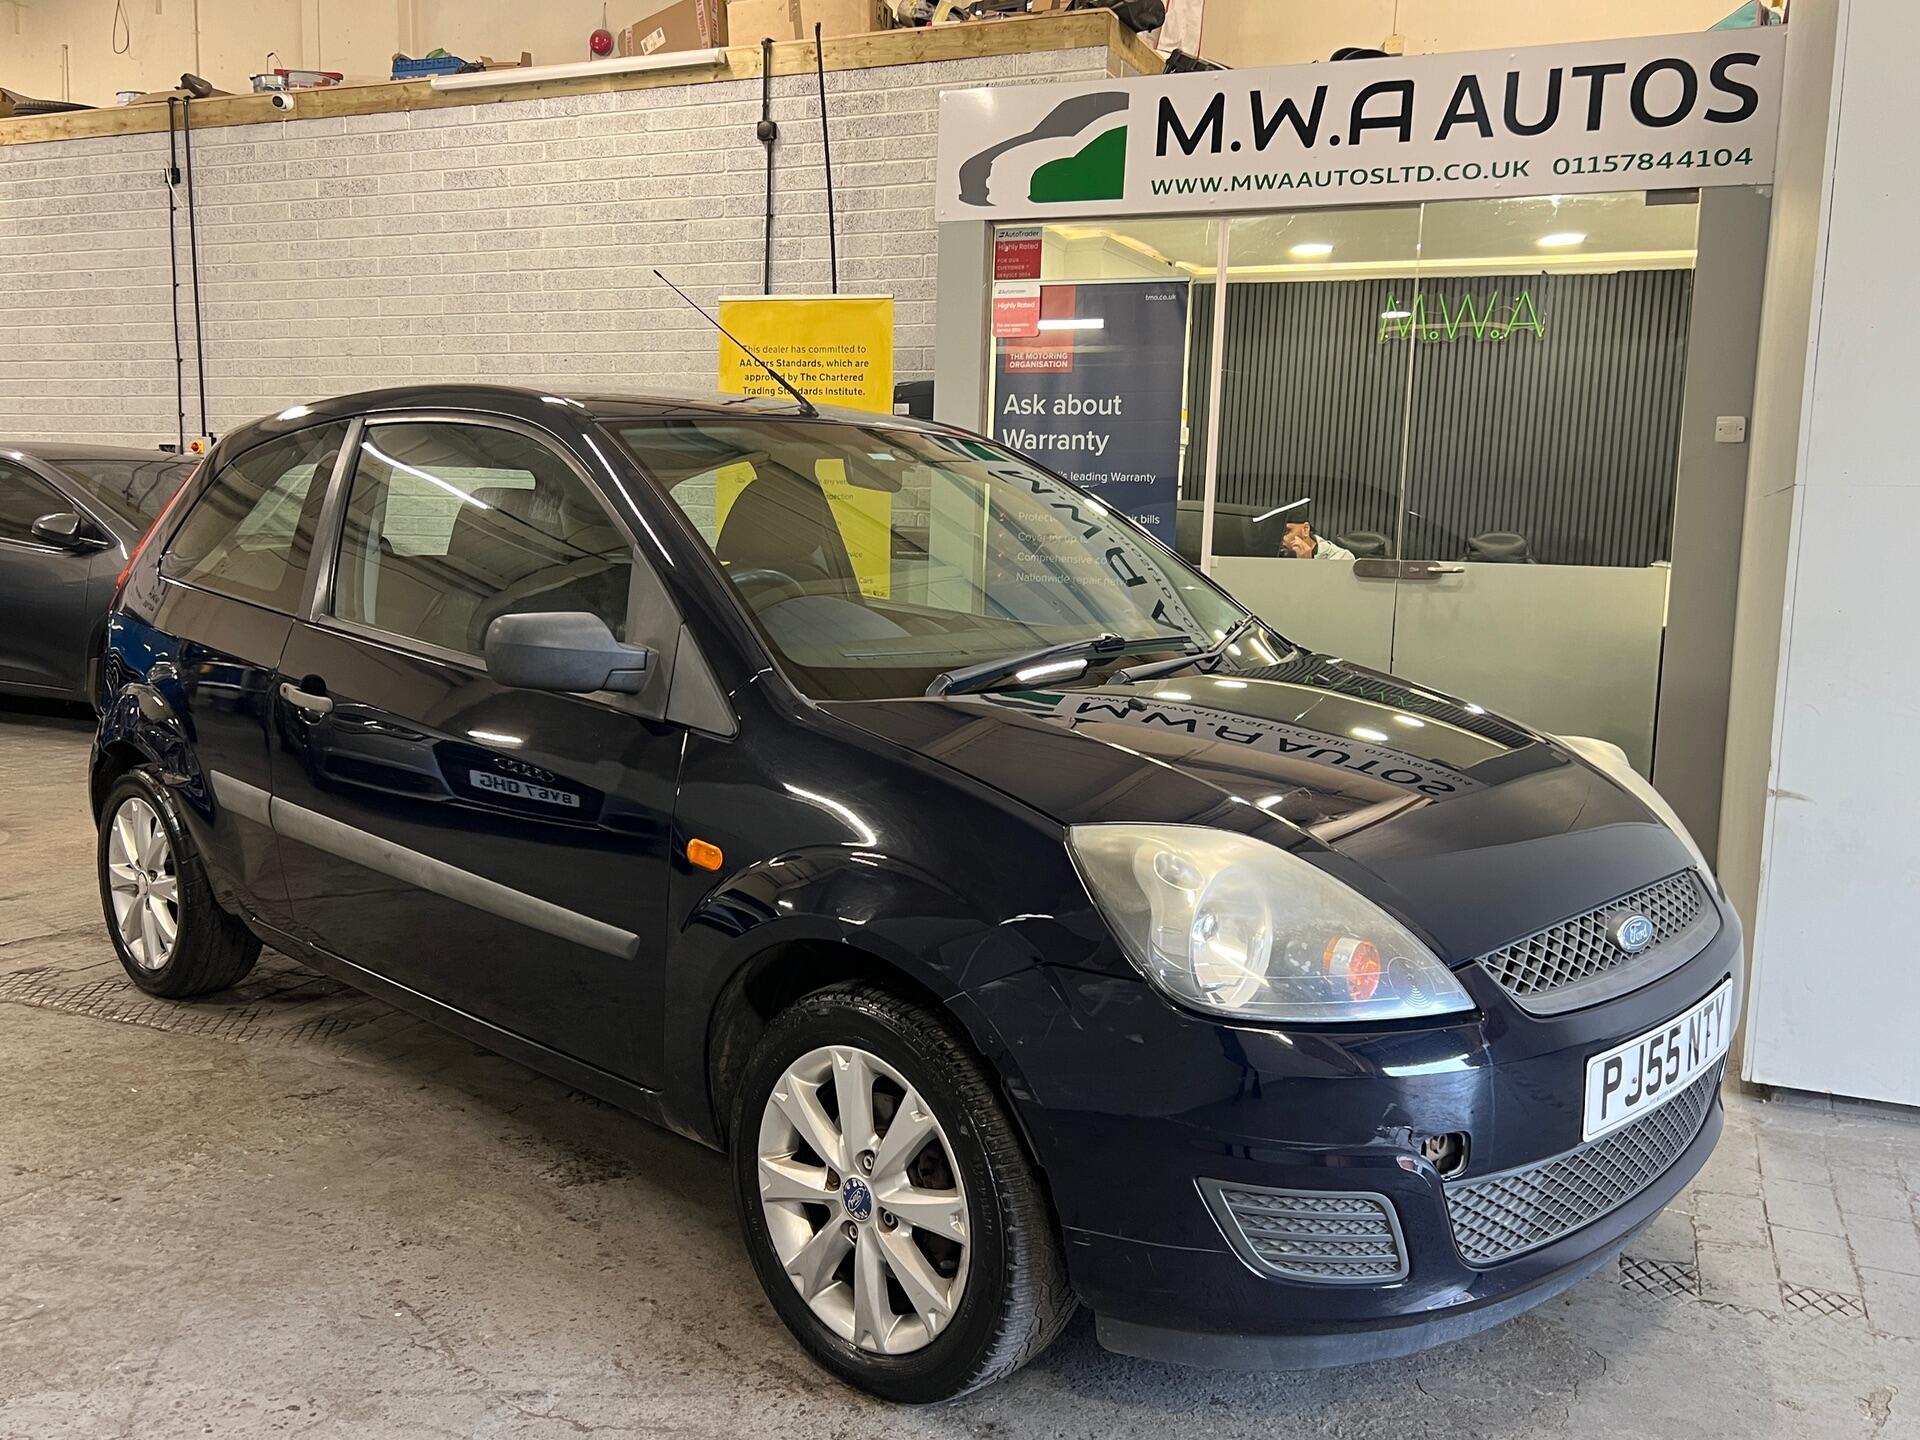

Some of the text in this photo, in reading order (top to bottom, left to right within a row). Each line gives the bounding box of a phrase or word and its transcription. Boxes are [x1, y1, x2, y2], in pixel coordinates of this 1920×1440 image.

[1155, 52, 1761, 157] M.W.A AUTOS
[1151, 147, 1753, 196] WWW.MWAAUTOSLTD.CO.UK 01157844104
[1019, 242, 1039, 250] Rated
[1145, 293, 1177, 301] tmo.co.uk
[1380, 289, 1544, 342] M.W.A
[762, 344, 789, 354] dealer
[791, 344, 806, 354] has
[808, 344, 855, 354] committed
[857, 344, 867, 354] to
[1010, 352, 1068, 360] THE MOTORING
[739, 359, 752, 368] AA
[776, 359, 824, 369] Standards,
[826, 359, 854, 368] which
[855, 360, 869, 368] are
[1009, 360, 1068, 368] ORGANISATION
[788, 373, 798, 383] by
[800, 372, 817, 381] The
[819, 372, 864, 382] Chartered
[743, 386, 776, 397] Trading
[825, 386, 866, 396] Institute.
[1003, 394, 1122, 416] Ask about
[1002, 429, 1110, 456] Warranty
[1070, 472, 1108, 484] leading
[1110, 472, 1156, 485] Warranty
[1140, 514, 1160, 524] bills
[1600, 992, 1727, 1121] PJ55 NTY
